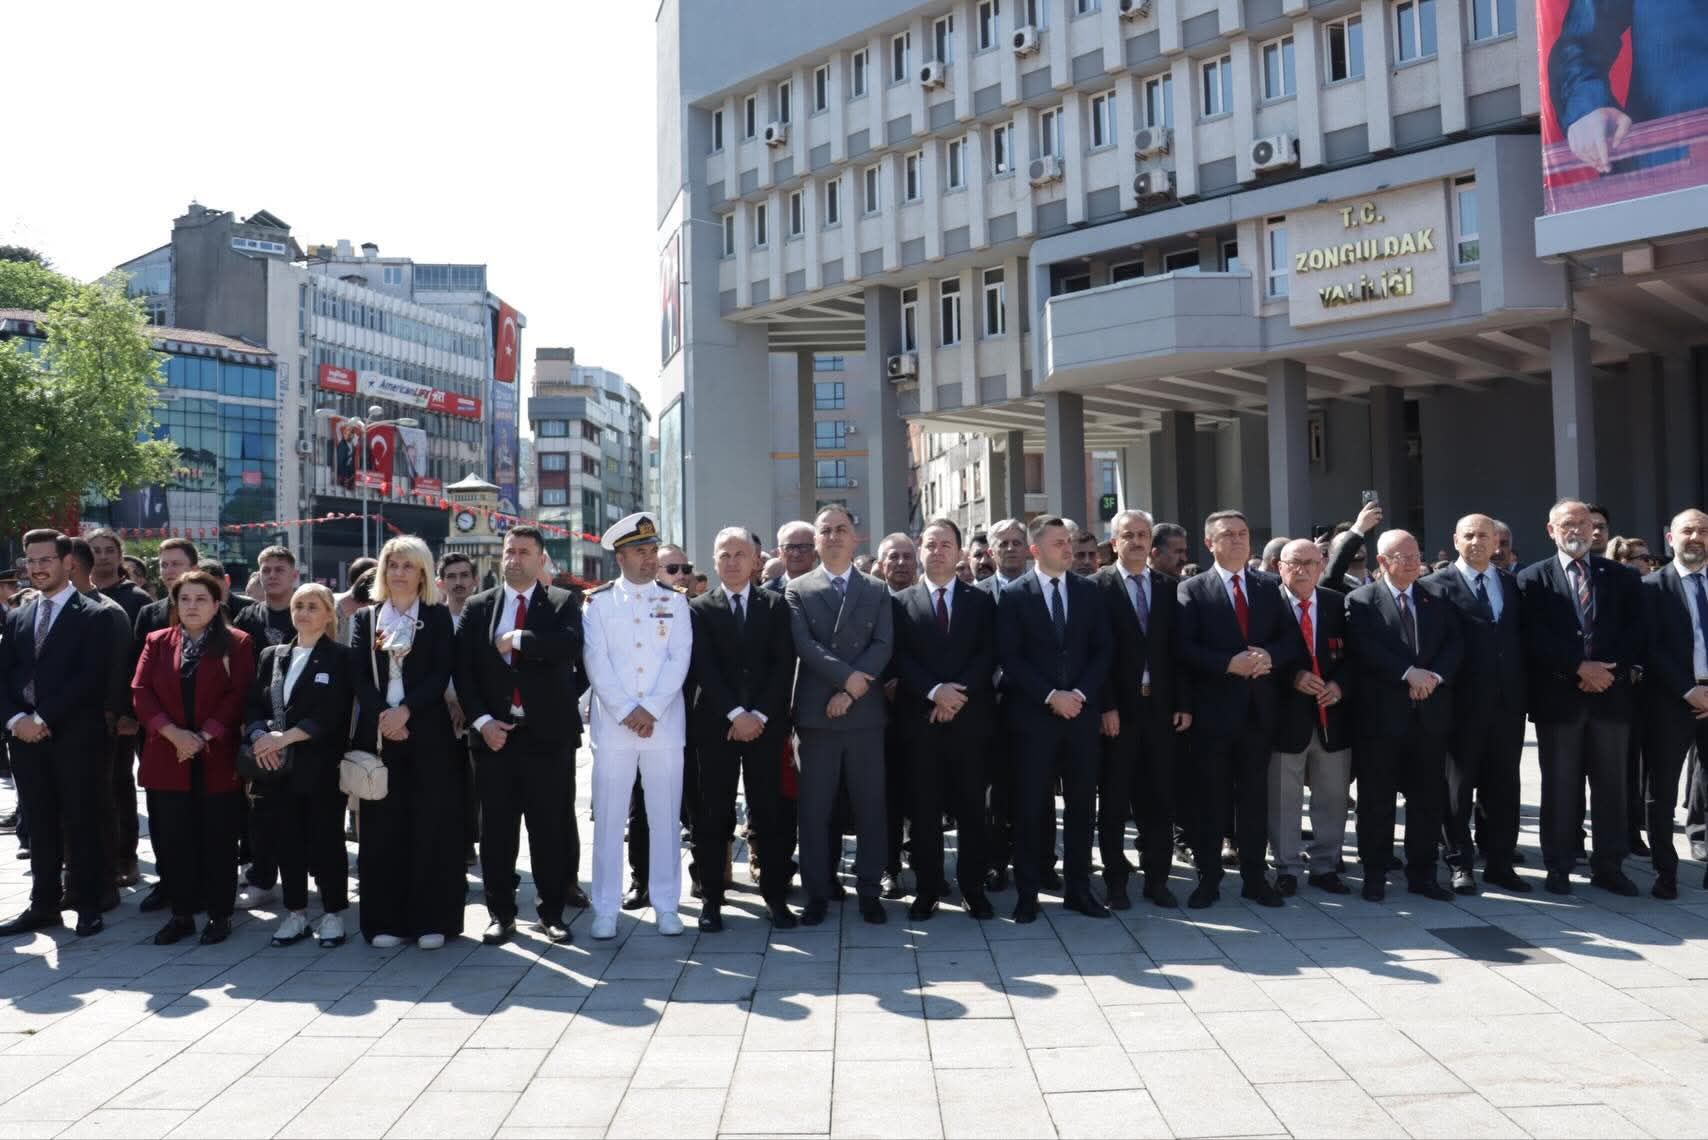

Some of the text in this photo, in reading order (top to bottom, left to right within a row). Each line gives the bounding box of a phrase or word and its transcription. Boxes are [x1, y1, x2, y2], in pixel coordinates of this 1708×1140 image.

[1340, 202, 1385, 229] T.C.
[1295, 228, 1434, 275] ZONGULDAK
[1319, 266, 1414, 309] VALİLİĞİ
